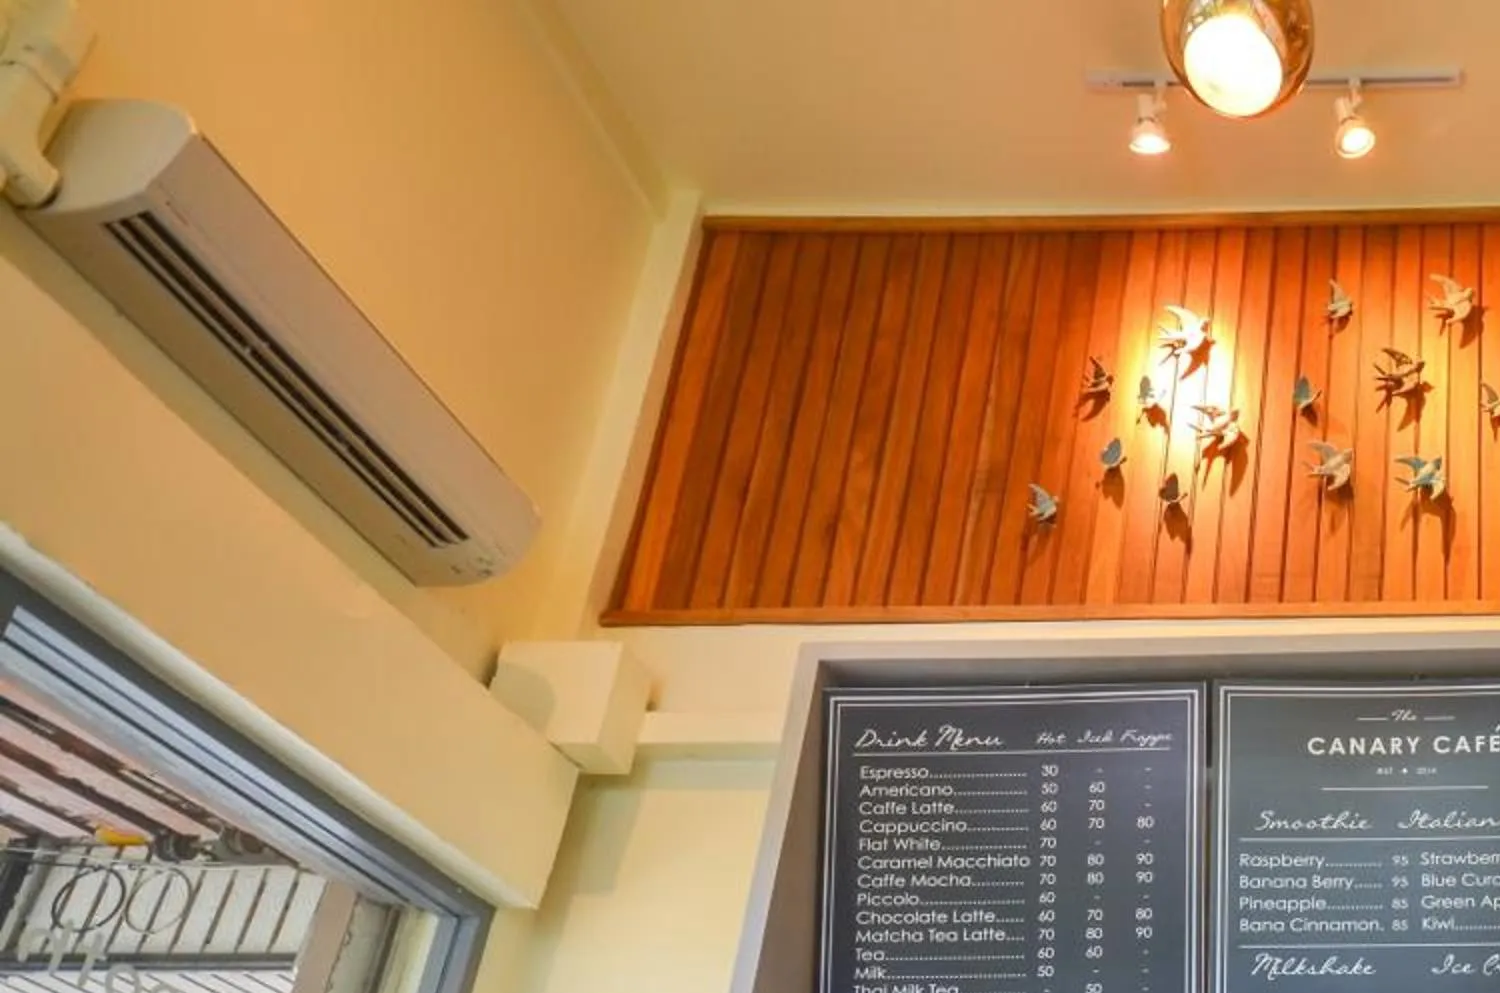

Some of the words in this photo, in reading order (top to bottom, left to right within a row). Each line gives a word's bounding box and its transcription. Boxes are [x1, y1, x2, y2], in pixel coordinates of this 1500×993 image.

[1391, 709, 1417, 721] The
[854, 728, 929, 748] Drink
[934, 723, 1008, 753] Menu
[1307, 735, 1420, 756] CANARY
[859, 765, 929, 782] Espresso
[858, 783, 953, 798] Americano
[1088, 780, 1106, 794] 60
[858, 801, 908, 816] Caffe
[911, 801, 954, 815] Latte
[1040, 799, 1058, 813] 60
[1088, 799, 1106, 812] 70
[858, 817, 967, 836] Cappuccino
[1039, 817, 1058, 831] 60
[1087, 817, 1106, 829] 70
[1135, 815, 1155, 829] 80
[1254, 809, 1372, 831] Smoothie
[858, 837, 889, 852] Flat
[894, 837, 941, 851] White
[1039, 836, 1057, 849] 70
[857, 855, 933, 871] Caramel
[937, 853, 1031, 869] Macchiato
[1039, 854, 1057, 867] 70
[1087, 853, 1105, 867] 80
[1135, 852, 1154, 865] 90
[1238, 852, 1326, 870] Raspberry
[1391, 854, 1409, 867] 95
[856, 873, 907, 889] Caffe
[910, 873, 972, 888] Mocha
[1039, 872, 1057, 885] 70
[1086, 871, 1105, 886] 80
[1135, 870, 1154, 884] 90
[1239, 874, 1308, 889] Banana
[1311, 874, 1353, 891] Berry
[1391, 875, 1410, 889] 95
[1421, 872, 1458, 888] Blue
[856, 892, 919, 907] Piccolo
[1038, 891, 1057, 904] 60
[1239, 895, 1327, 914] Pineapple
[1420, 894, 1476, 910] Green
[855, 909, 949, 925] Chocolate
[952, 909, 996, 924] Latte
[1037, 909, 1056, 923] 60
[1087, 908, 1104, 921] 70
[1135, 907, 1153, 921] 80
[1239, 917, 1286, 933] Bana
[1391, 919, 1409, 932] 85
[1421, 916, 1455, 931] Kiwi
[855, 929, 925, 944] Matcha
[928, 928, 958, 943] Tea
[962, 927, 1006, 942] Latte
[1038, 927, 1056, 941] 70
[1084, 927, 1104, 940] 80
[1135, 925, 1153, 939] 90
[855, 947, 885, 962] Tea
[1036, 946, 1056, 959] 60
[1085, 944, 1104, 959] 60
[853, 966, 886, 980] Milk
[1036, 964, 1055, 978] 50
[1250, 952, 1377, 981] Milkshake
[1430, 953, 1476, 975] Ice
